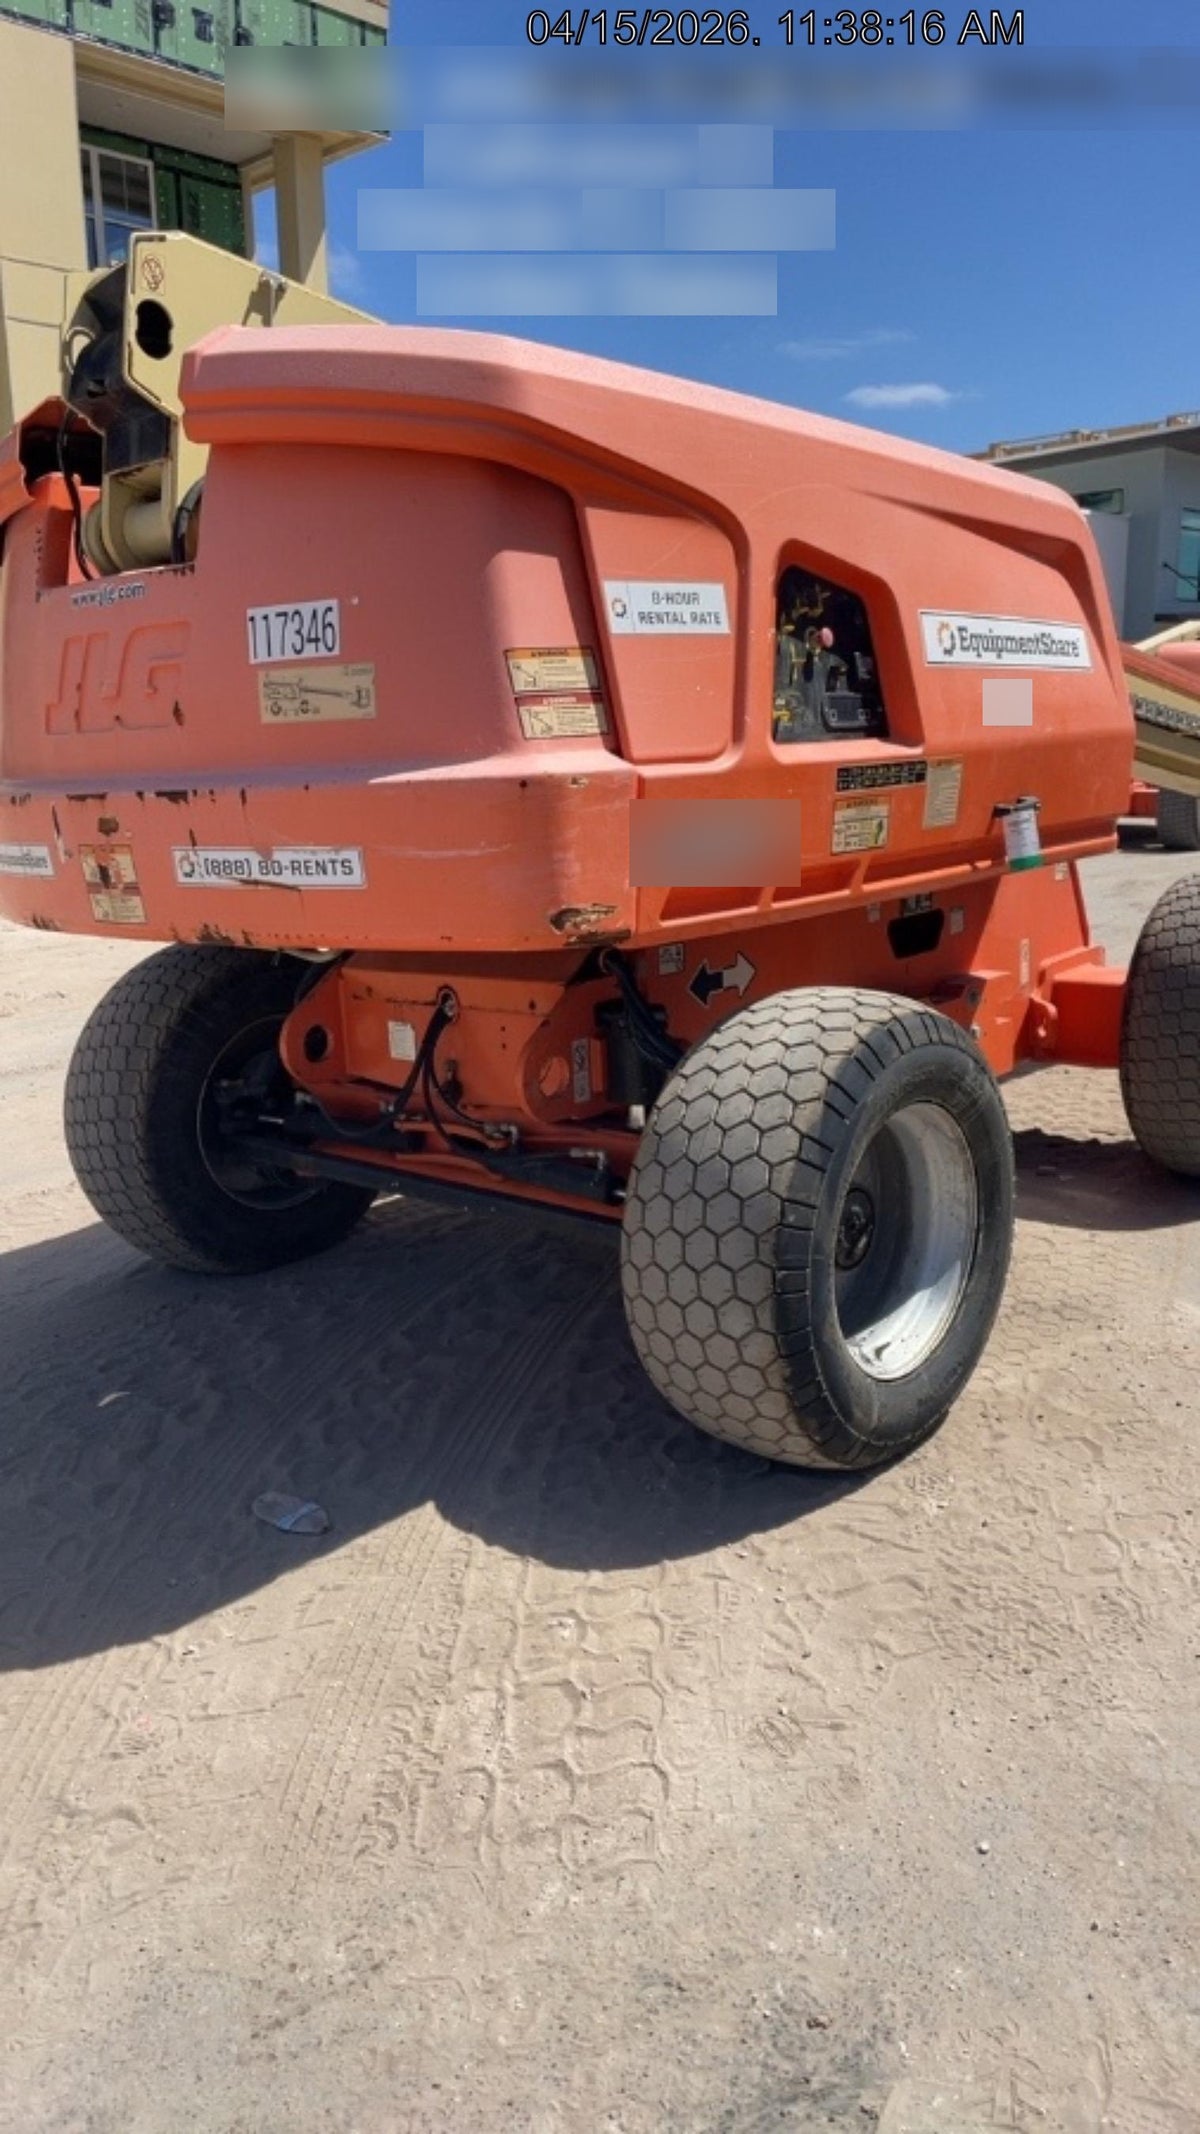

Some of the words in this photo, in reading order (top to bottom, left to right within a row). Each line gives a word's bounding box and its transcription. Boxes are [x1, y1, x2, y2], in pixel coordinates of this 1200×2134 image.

[248, 606, 336, 660] 117346
[638, 611, 688, 625] RENTAL
[690, 611, 722, 625] RATE
[957, 626, 1080, 660] EquipmentShare
[45, 621, 191, 735] JLG
[203, 857, 252, 877] (888)
